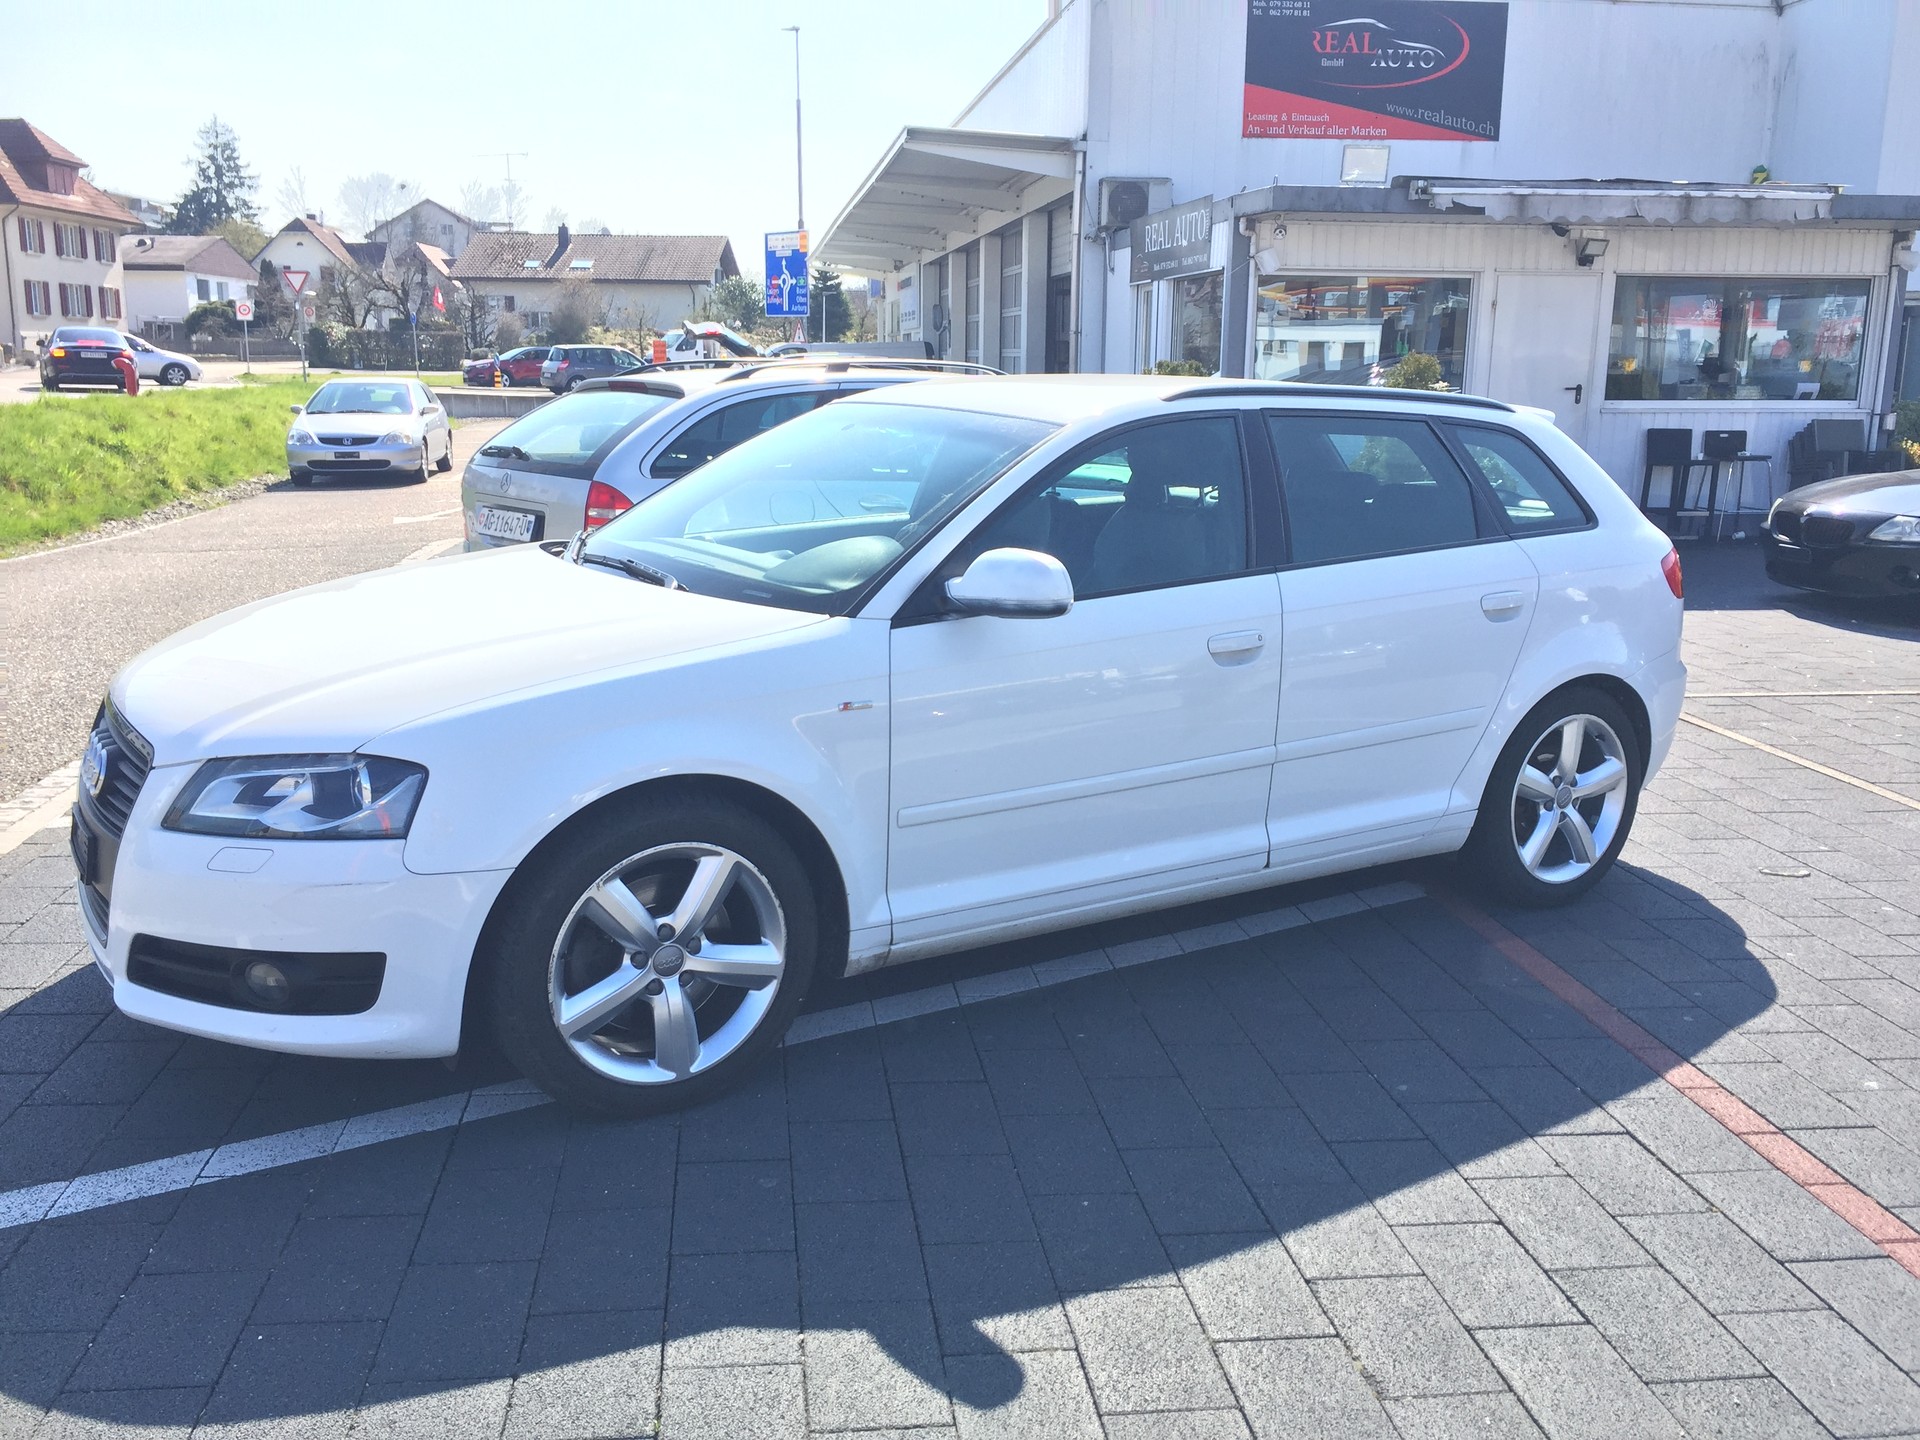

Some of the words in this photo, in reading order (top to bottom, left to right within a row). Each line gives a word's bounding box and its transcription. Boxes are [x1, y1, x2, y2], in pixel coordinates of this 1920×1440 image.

[1312, 30, 1378, 54] REAL
[1321, 58, 1344, 67] GmbH
[1370, 49, 1436, 68] AUTO
[1247, 112, 1278, 122] Leasing
[1281, 113, 1288, 121] &
[1291, 113, 1330, 122] Eintausch
[1386, 103, 1495, 136] www.realauto.ch
[1247, 125, 1264, 134] An-
[1266, 124, 1285, 134] und
[1287, 125, 1326, 135] Verkauf
[1326, 126, 1349, 135] aller
[1350, 126, 1387, 136] Marken
[1145, 220, 1172, 253] REAL
[1173, 209, 1206, 247] AUTO
